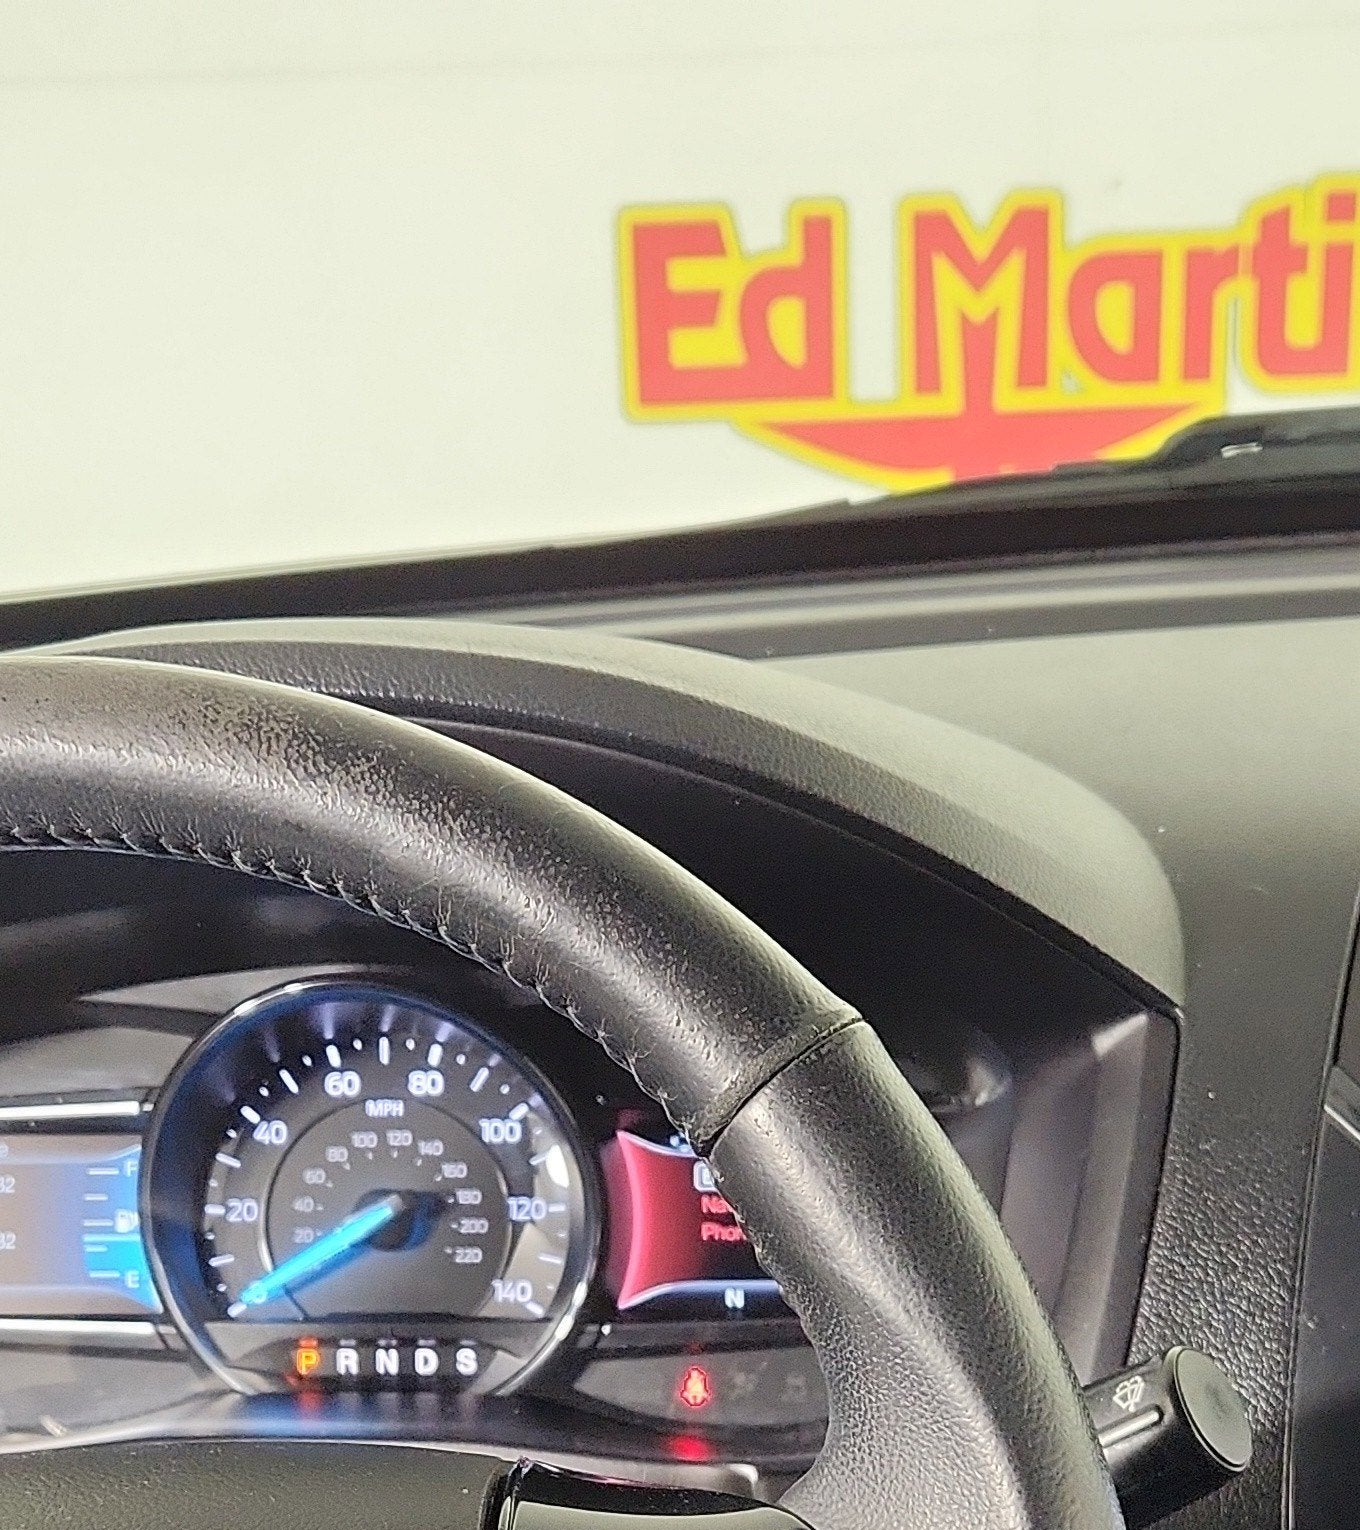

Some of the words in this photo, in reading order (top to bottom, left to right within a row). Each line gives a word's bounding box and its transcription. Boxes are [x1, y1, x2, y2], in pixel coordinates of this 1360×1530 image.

[628, 210, 838, 404] Ed
[324, 1071, 361, 1097] 60
[408, 1070, 445, 1096] 80
[365, 1100, 405, 1117] MPH
[253, 1121, 287, 1146] 40
[351, 1132, 378, 1149] 100
[385, 1129, 413, 1147] 120
[479, 1119, 521, 1144] 100
[326, 1146, 349, 1163] 80
[417, 1140, 444, 1157] 140
[303, 1168, 327, 1185] 60
[441, 1163, 469, 1179] 160
[293, 1197, 315, 1213] 40
[454, 1189, 482, 1206] 180
[226, 1198, 259, 1223] 20
[507, 1197, 547, 1221] 120
[458, 1217, 489, 1235] 200
[293, 1227, 315, 1244] 20
[454, 1247, 483, 1264] 220
[125, 1271, 139, 1287] E
[493, 1279, 532, 1302] 140
[724, 1287, 745, 1308] N
[297, 1347, 321, 1375] P
[336, 1347, 359, 1376] R
[375, 1347, 400, 1376] N
[414, 1347, 439, 1376] D
[455, 1346, 479, 1376] S
